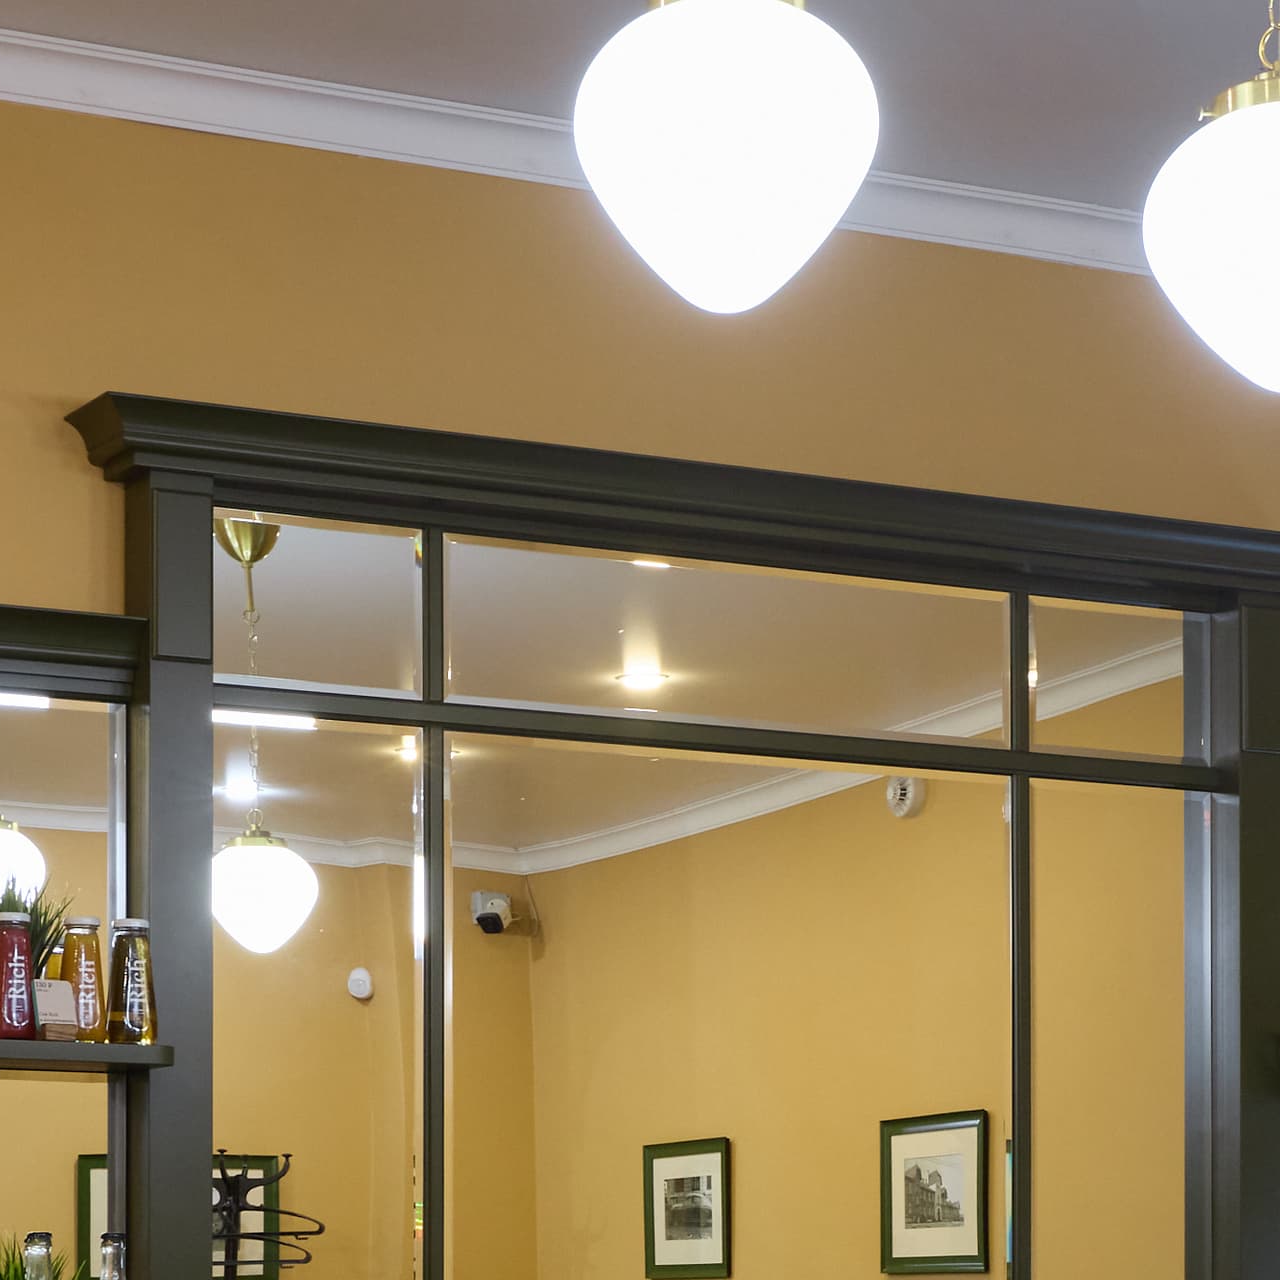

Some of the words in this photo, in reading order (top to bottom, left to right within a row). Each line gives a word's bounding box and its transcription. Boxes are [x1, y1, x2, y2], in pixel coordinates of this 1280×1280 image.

[7, 953, 25, 1001] Rich
[78, 960, 96, 1001] Rich
[129, 957, 147, 1003] Rich
